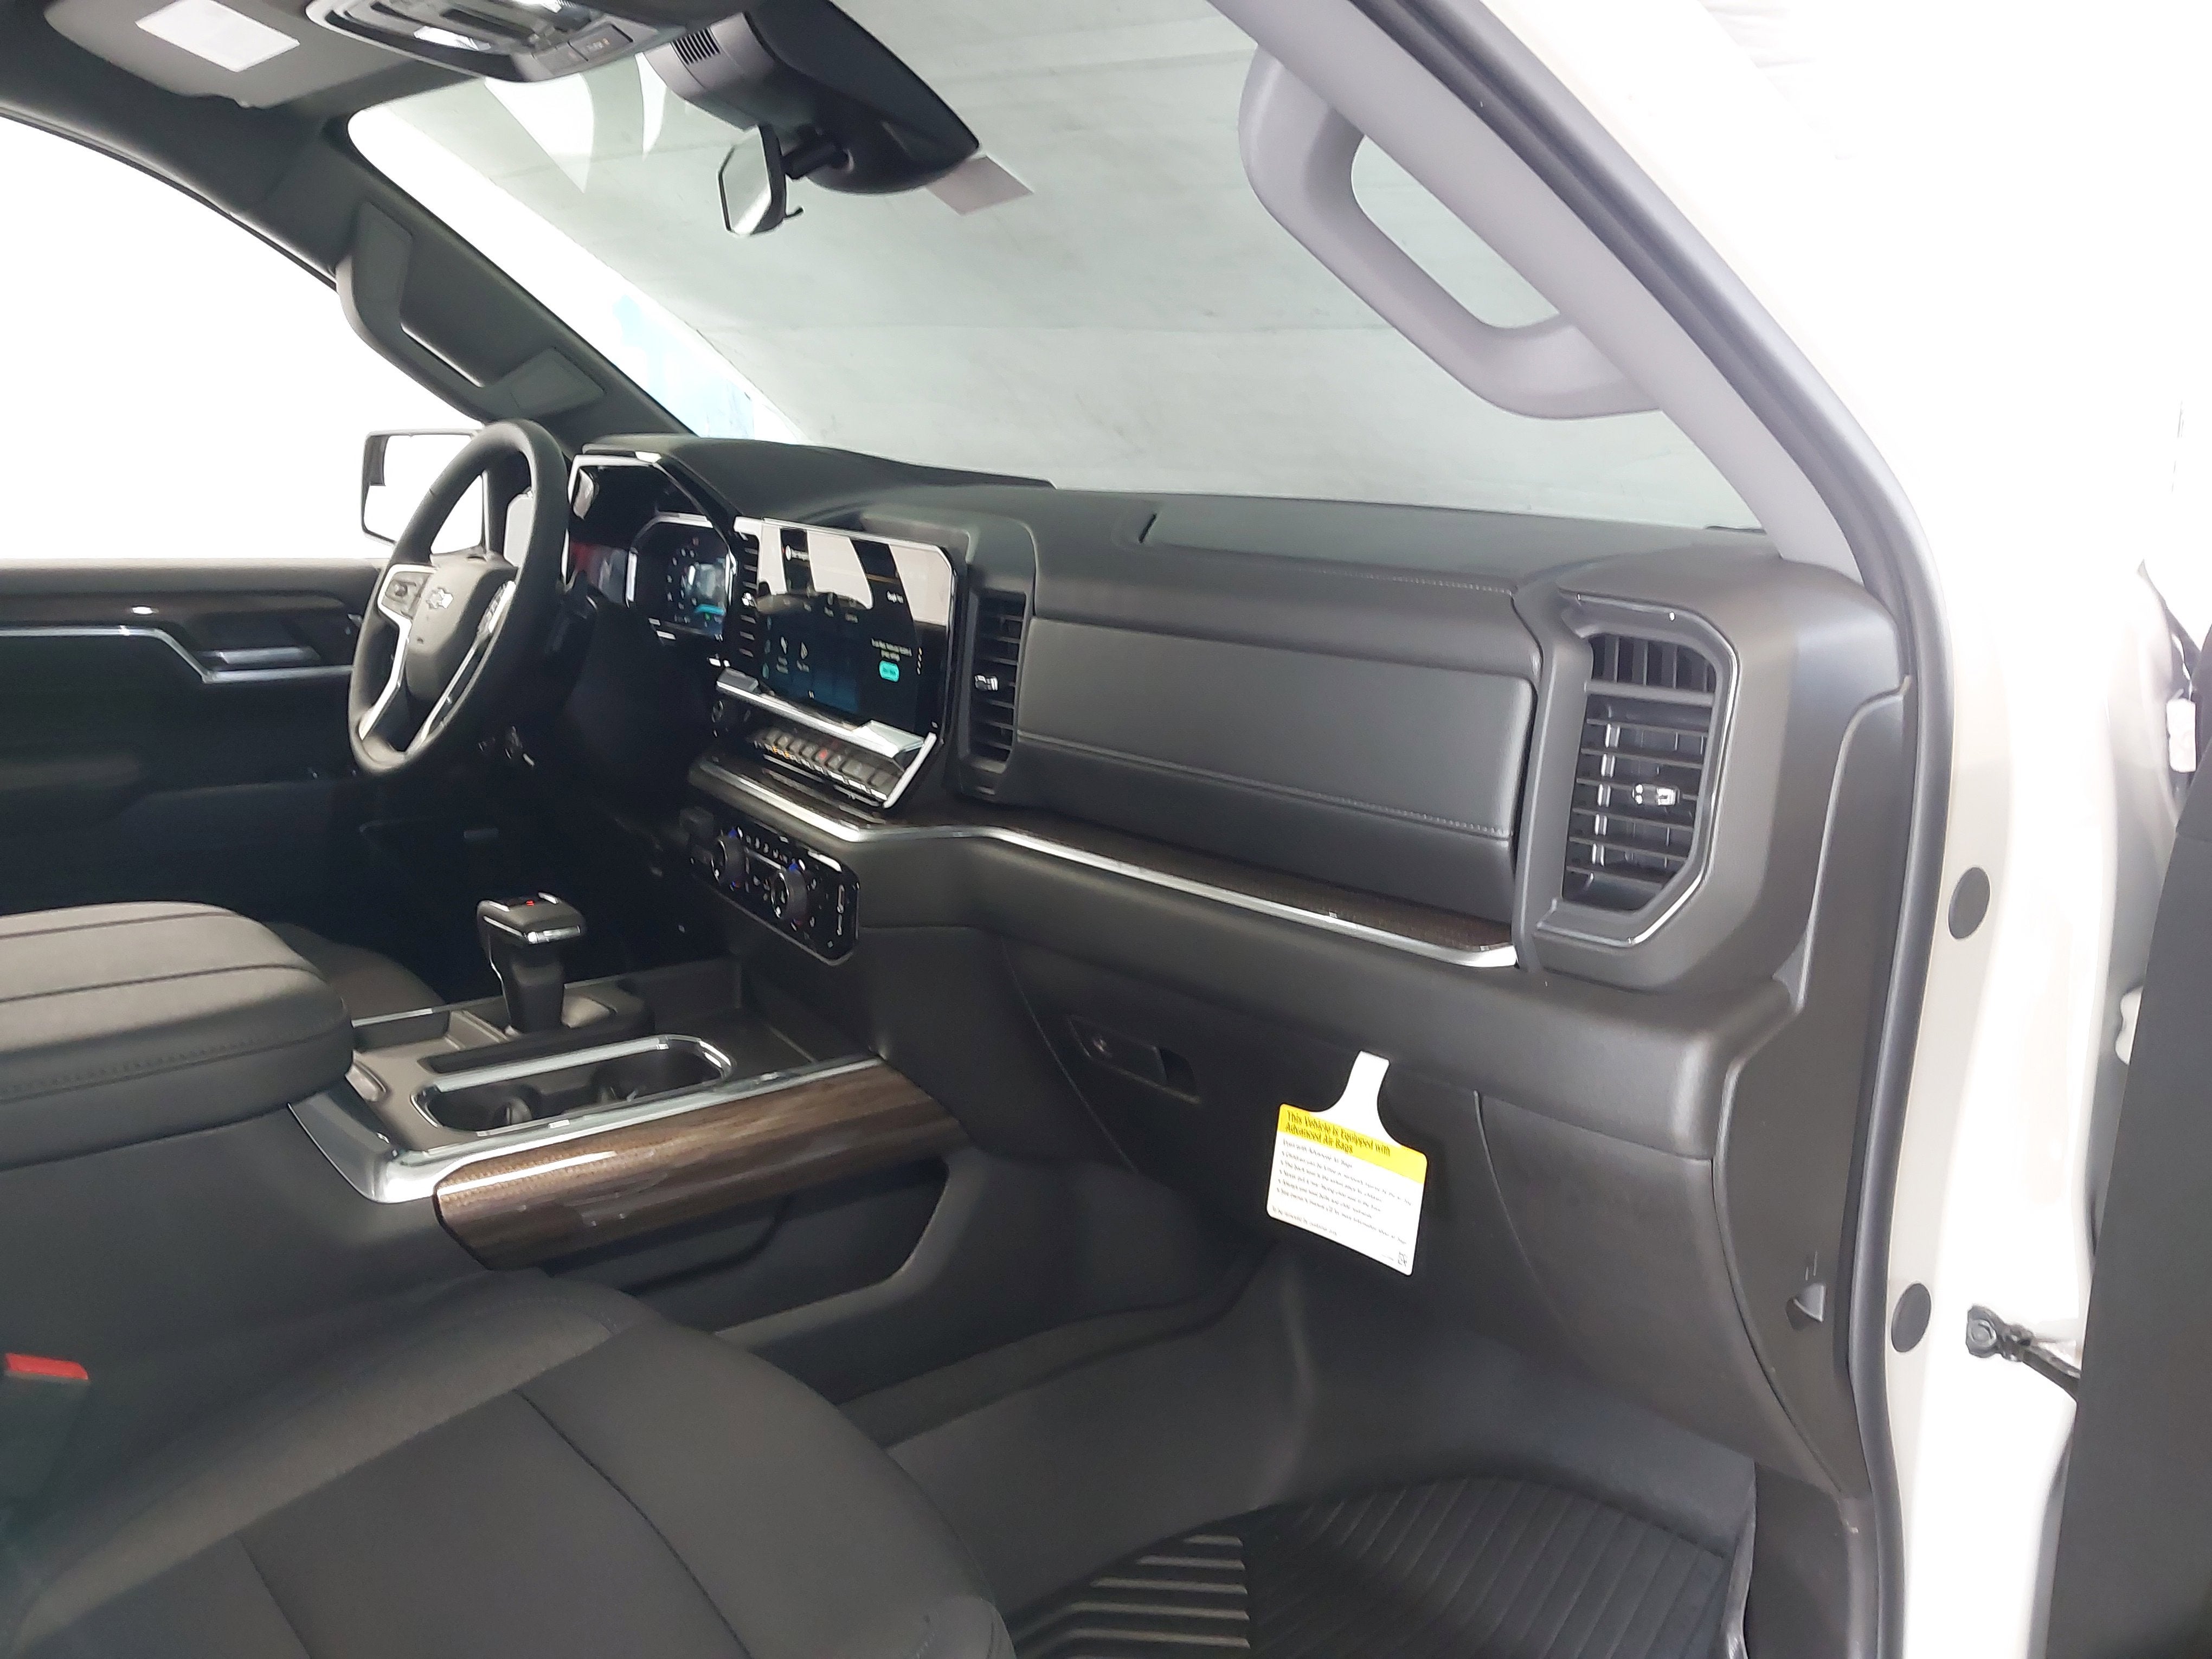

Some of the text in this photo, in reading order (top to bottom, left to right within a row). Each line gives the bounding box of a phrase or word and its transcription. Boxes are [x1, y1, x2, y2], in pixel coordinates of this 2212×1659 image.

[1286, 1123, 1321, 1142] Advanced
[1323, 1135, 1334, 1147] Air
[1336, 1139, 1353, 1154] Bags
[1287, 1110, 1302, 1124] This
[1304, 1115, 1330, 1134] Vehicle
[1341, 1128, 1373, 1150] Equipped
[1375, 1143, 1391, 1157] with
